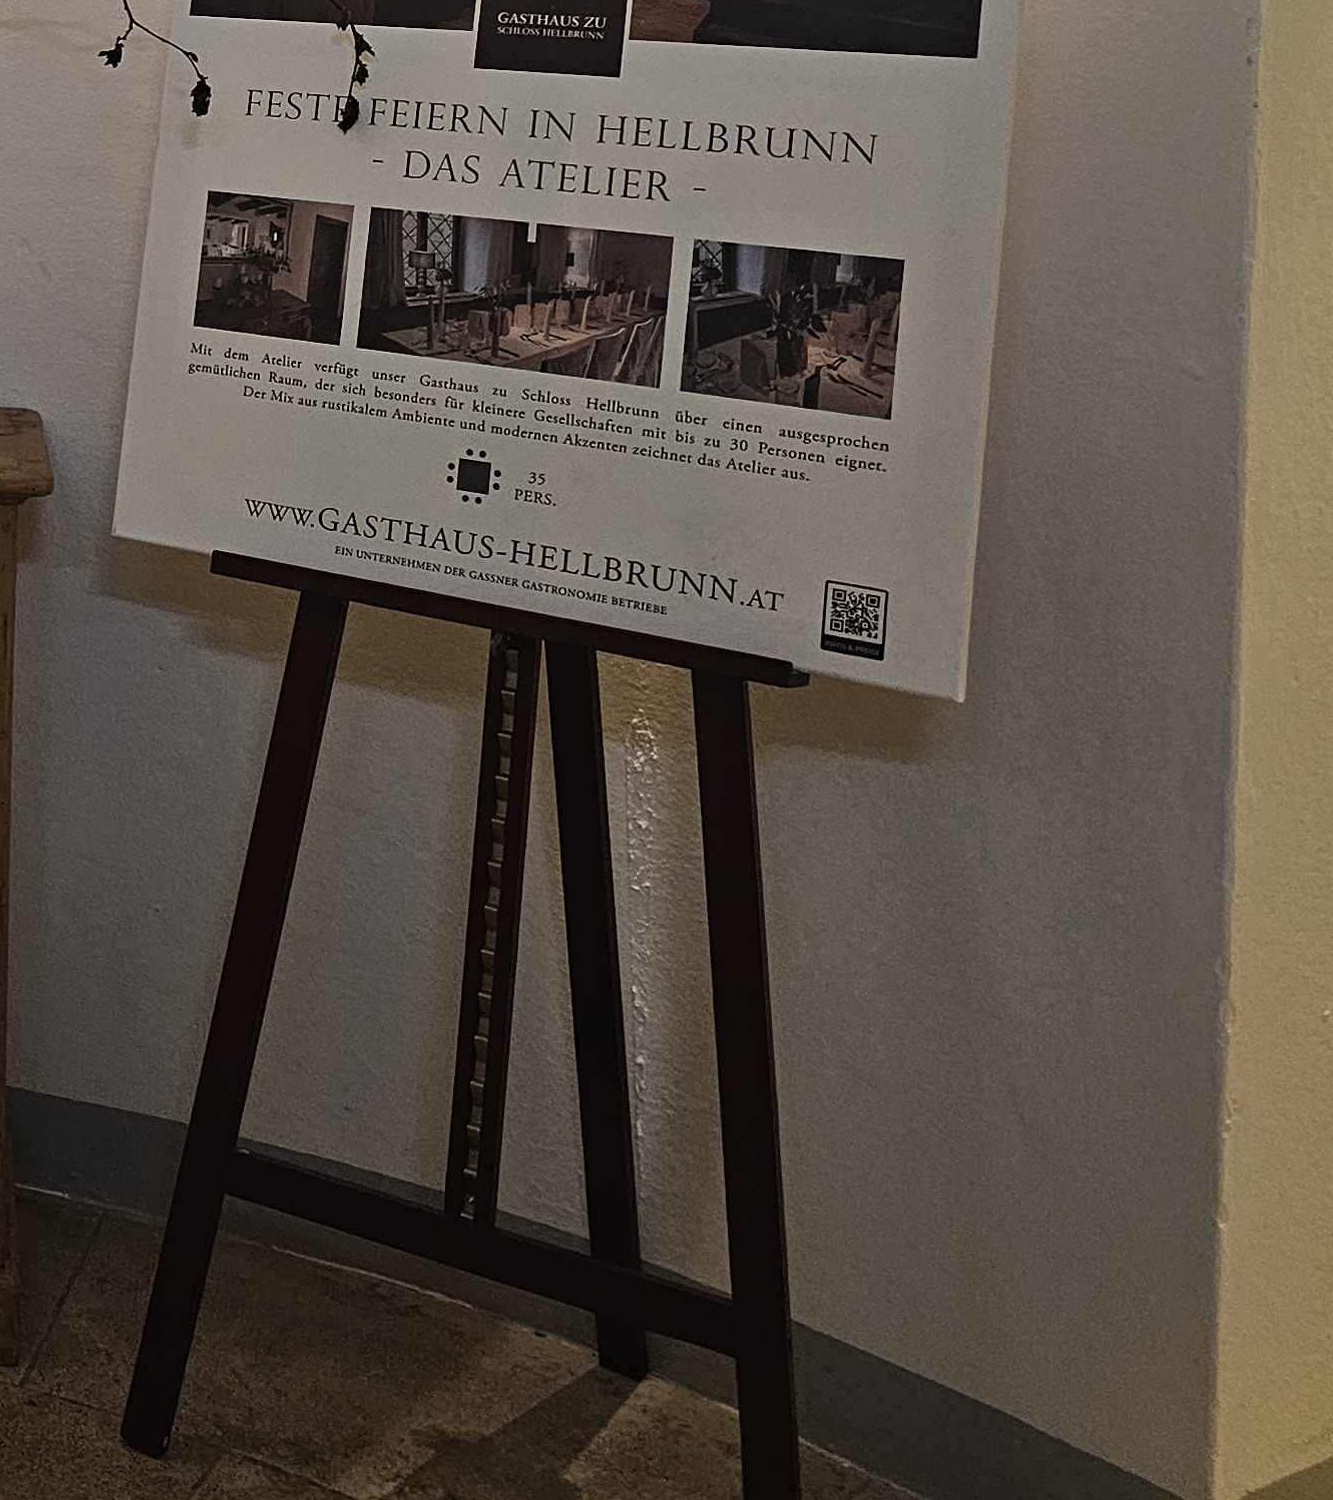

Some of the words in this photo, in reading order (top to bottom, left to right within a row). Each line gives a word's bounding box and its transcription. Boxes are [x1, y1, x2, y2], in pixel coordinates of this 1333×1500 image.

[497, 26, 540, 36] SCHLOSS
[543, 29, 604, 39] HELLBRUNN
[498, 12, 580, 27] GASTHAUS
[583, 17, 606, 28] ZU
[367, 98, 508, 135] FEIERN
[528, 109, 576, 141] IN
[596, 115, 878, 164] HELLBRUNN
[403, 150, 480, 184] DAS
[499, 159, 670, 202] ATELIER
[188, 364, 260, 380] gemütlichen
[269, 371, 307, 389] Raum,
[315, 378, 335, 391] der
[342, 383, 365, 396] sich
[374, 386, 436, 406] besonders
[444, 396, 464, 410] für
[472, 400, 525, 419] kleinere
[534, 410, 632, 434] Gesellschaften
[642, 427, 666, 439] mit
[675, 430, 695, 444] bis
[704, 438, 720, 448] zu
[730, 439, 748, 451] 30
[758, 442, 825, 463] Personen
[835, 455, 887, 472] eignet.
[191, 343, 212, 356] Mit
[224, 347, 249, 361] dem
[261, 353, 302, 368] Atelier
[314, 362, 359, 379] verfügt
[372, 372, 406, 383] unser
[420, 375, 478, 393] Gasthaus
[492, 388, 506, 397] zu
[521, 389, 571, 406] Schloss
[586, 397, 659, 419] Hellbrunn
[676, 410, 707, 426] über
[723, 418, 762, 434] einen
[779, 429, 889, 452] ausgesprochen
[243, 386, 266, 399] Der
[270, 390, 294, 404] Mix
[298, 398, 317, 407] aus
[322, 401, 387, 417] rustikalem
[392, 408, 455, 427] Ambiente
[460, 420, 485, 432] und
[491, 425, 558, 443] modernen
[562, 434, 627, 453] Akzenten
[633, 446, 692, 463] zeichnet
[698, 453, 720, 468] das
[725, 458, 776, 476] Atelier
[782, 469, 810, 481] aus.
[514, 489, 556, 506] PERS.
[528, 472, 545, 485] 35
[245, 498, 784, 611] WWW.GASTHAUS-HELLBRUNN.AT
[335, 546, 353, 556] EIN
[357, 550, 441, 572] UNTERNEHMEN
[444, 566, 466, 577] DER
[469, 571, 518, 587] GASSNER
[522, 580, 607, 603] GASTRONOMIE
[611, 596, 667, 615] BETRIEBE
